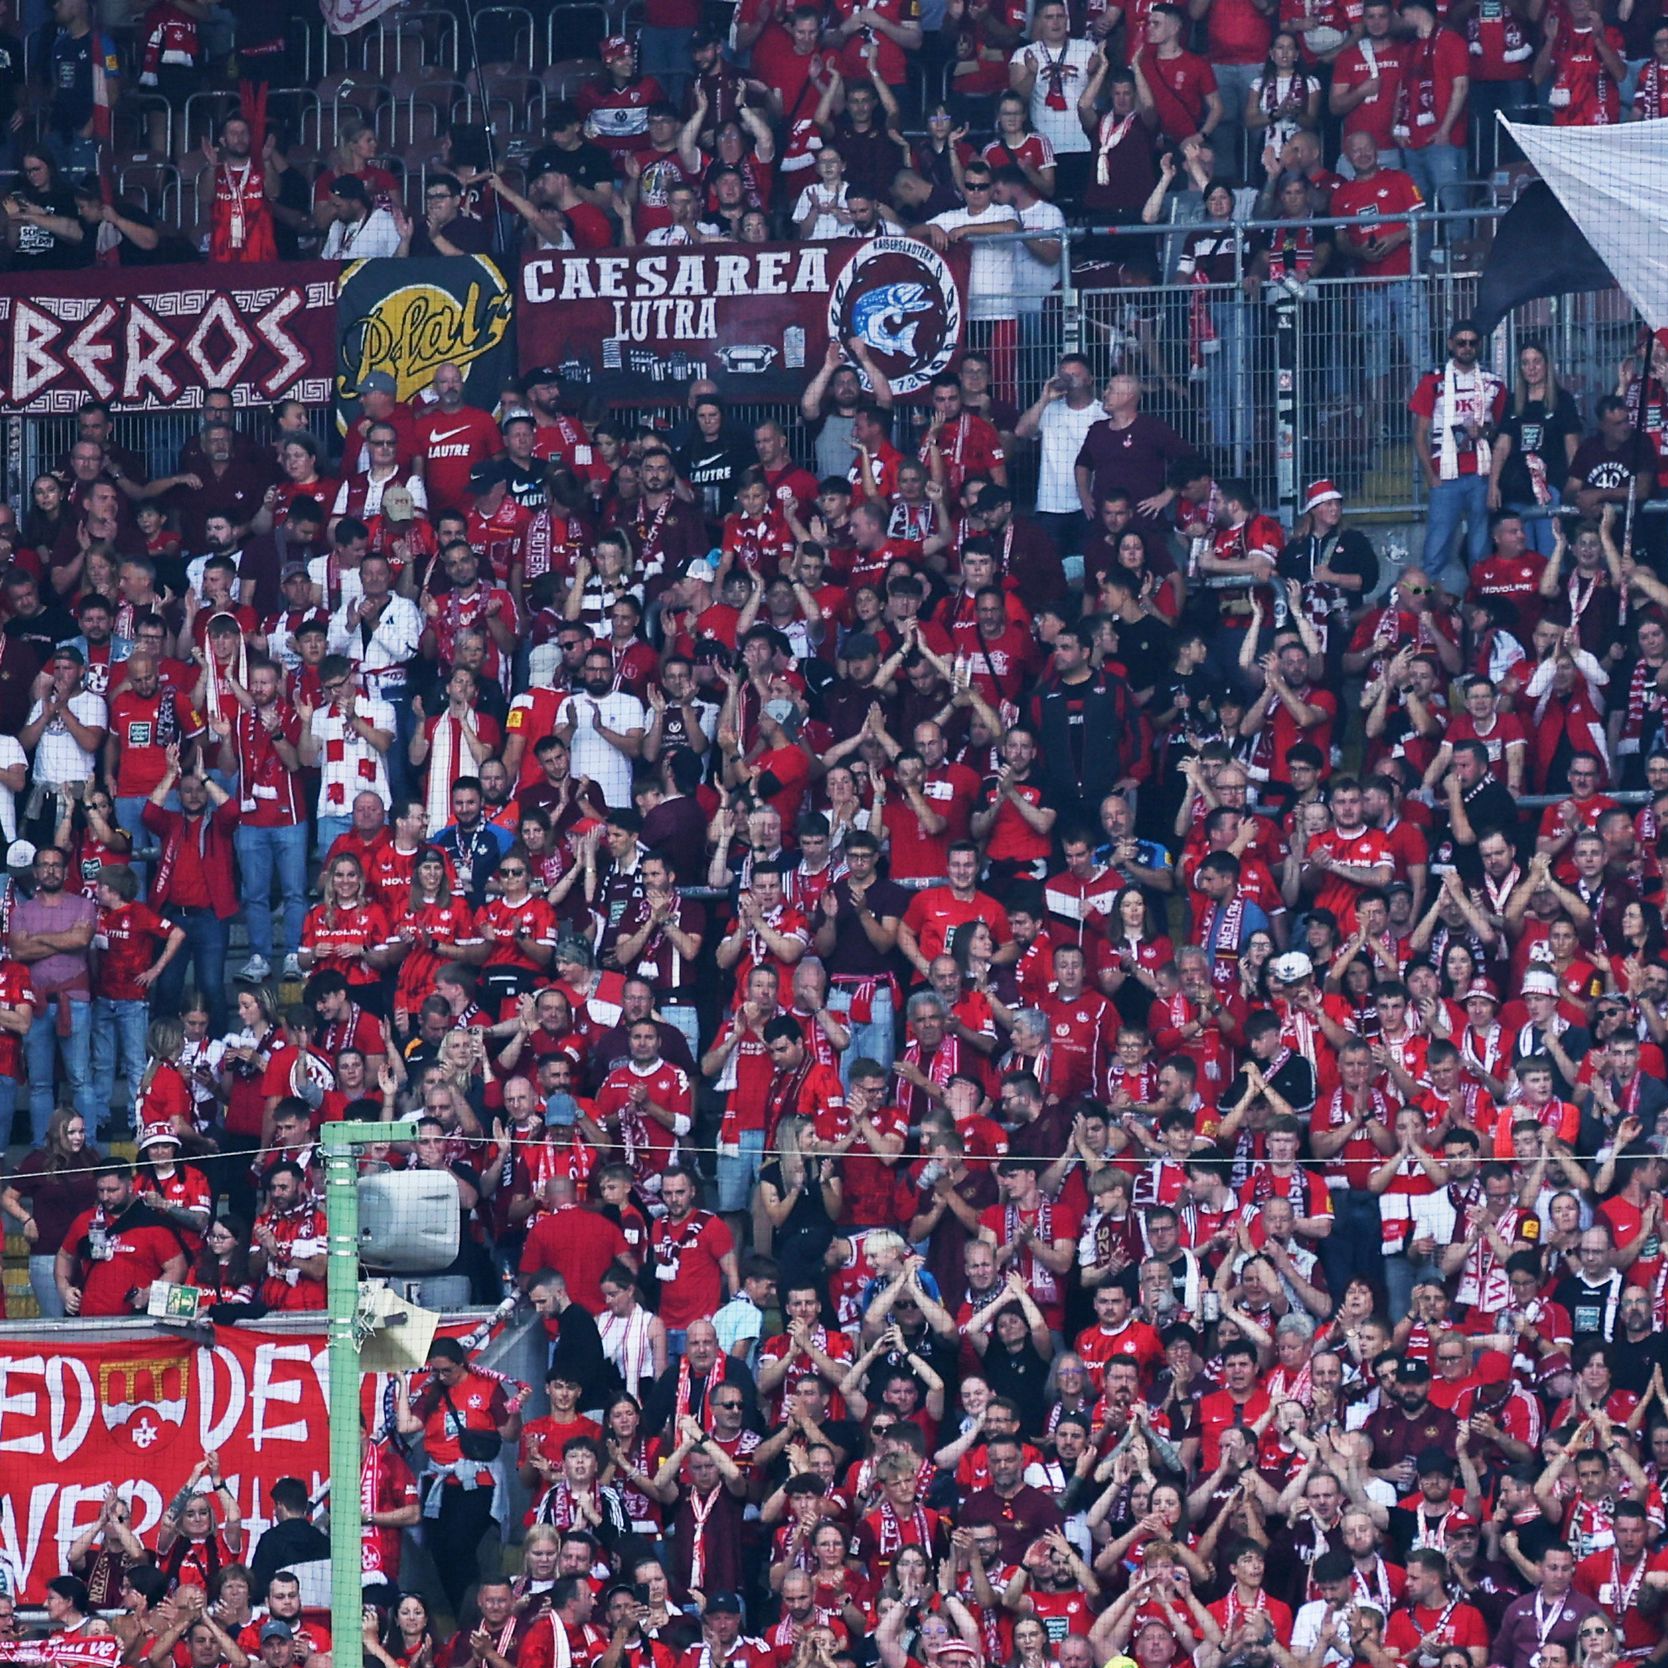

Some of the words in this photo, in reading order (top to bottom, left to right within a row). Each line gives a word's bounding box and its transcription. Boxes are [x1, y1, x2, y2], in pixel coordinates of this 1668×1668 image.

[872, 235, 937, 261] KAISERSLAUTERN
[523, 246, 831, 306] CAESAREA
[341, 281, 513, 393] Pfalz
[613, 298, 719, 343] LUTRA
[0, 286, 307, 404] BEROS
[427, 443, 471, 459] LAUTRE
[688, 466, 732, 484] LAUTRE
[514, 492, 547, 505] LAUT
